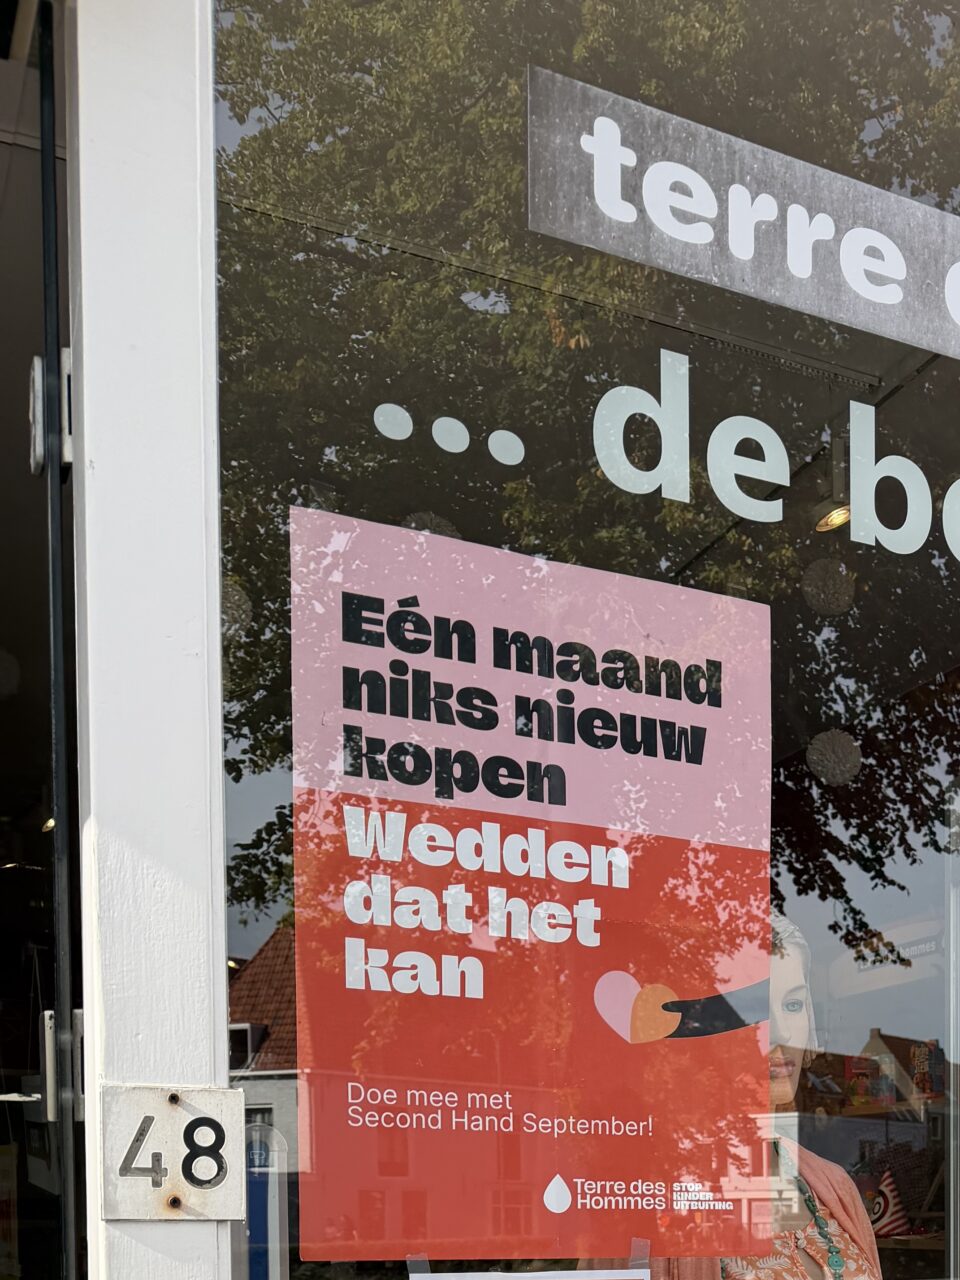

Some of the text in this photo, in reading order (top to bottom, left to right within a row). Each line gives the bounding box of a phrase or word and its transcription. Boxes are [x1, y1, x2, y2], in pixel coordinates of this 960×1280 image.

[580, 116, 907, 304] terre
[593, 348, 791, 523] de
[342, 591, 722, 708] Eén maand
[342, 659, 707, 765] niks nieuw
[343, 724, 567, 806] kopen
[343, 805, 629, 888] Wedden
[344, 875, 601, 947] dat het
[345, 937, 484, 999] kan
[347, 1082, 513, 1109] Doe mee met
[347, 1107, 654, 1138] Second Hand September!
[119, 1115, 228, 1190] 48
[573, 1179, 666, 1194] Terre des
[577, 1194, 666, 1210] Hommes
[673, 1183, 703, 1191] STOP
[673, 1192, 713, 1200] KINDER
[673, 1201, 734, 1210] UITBUITING
